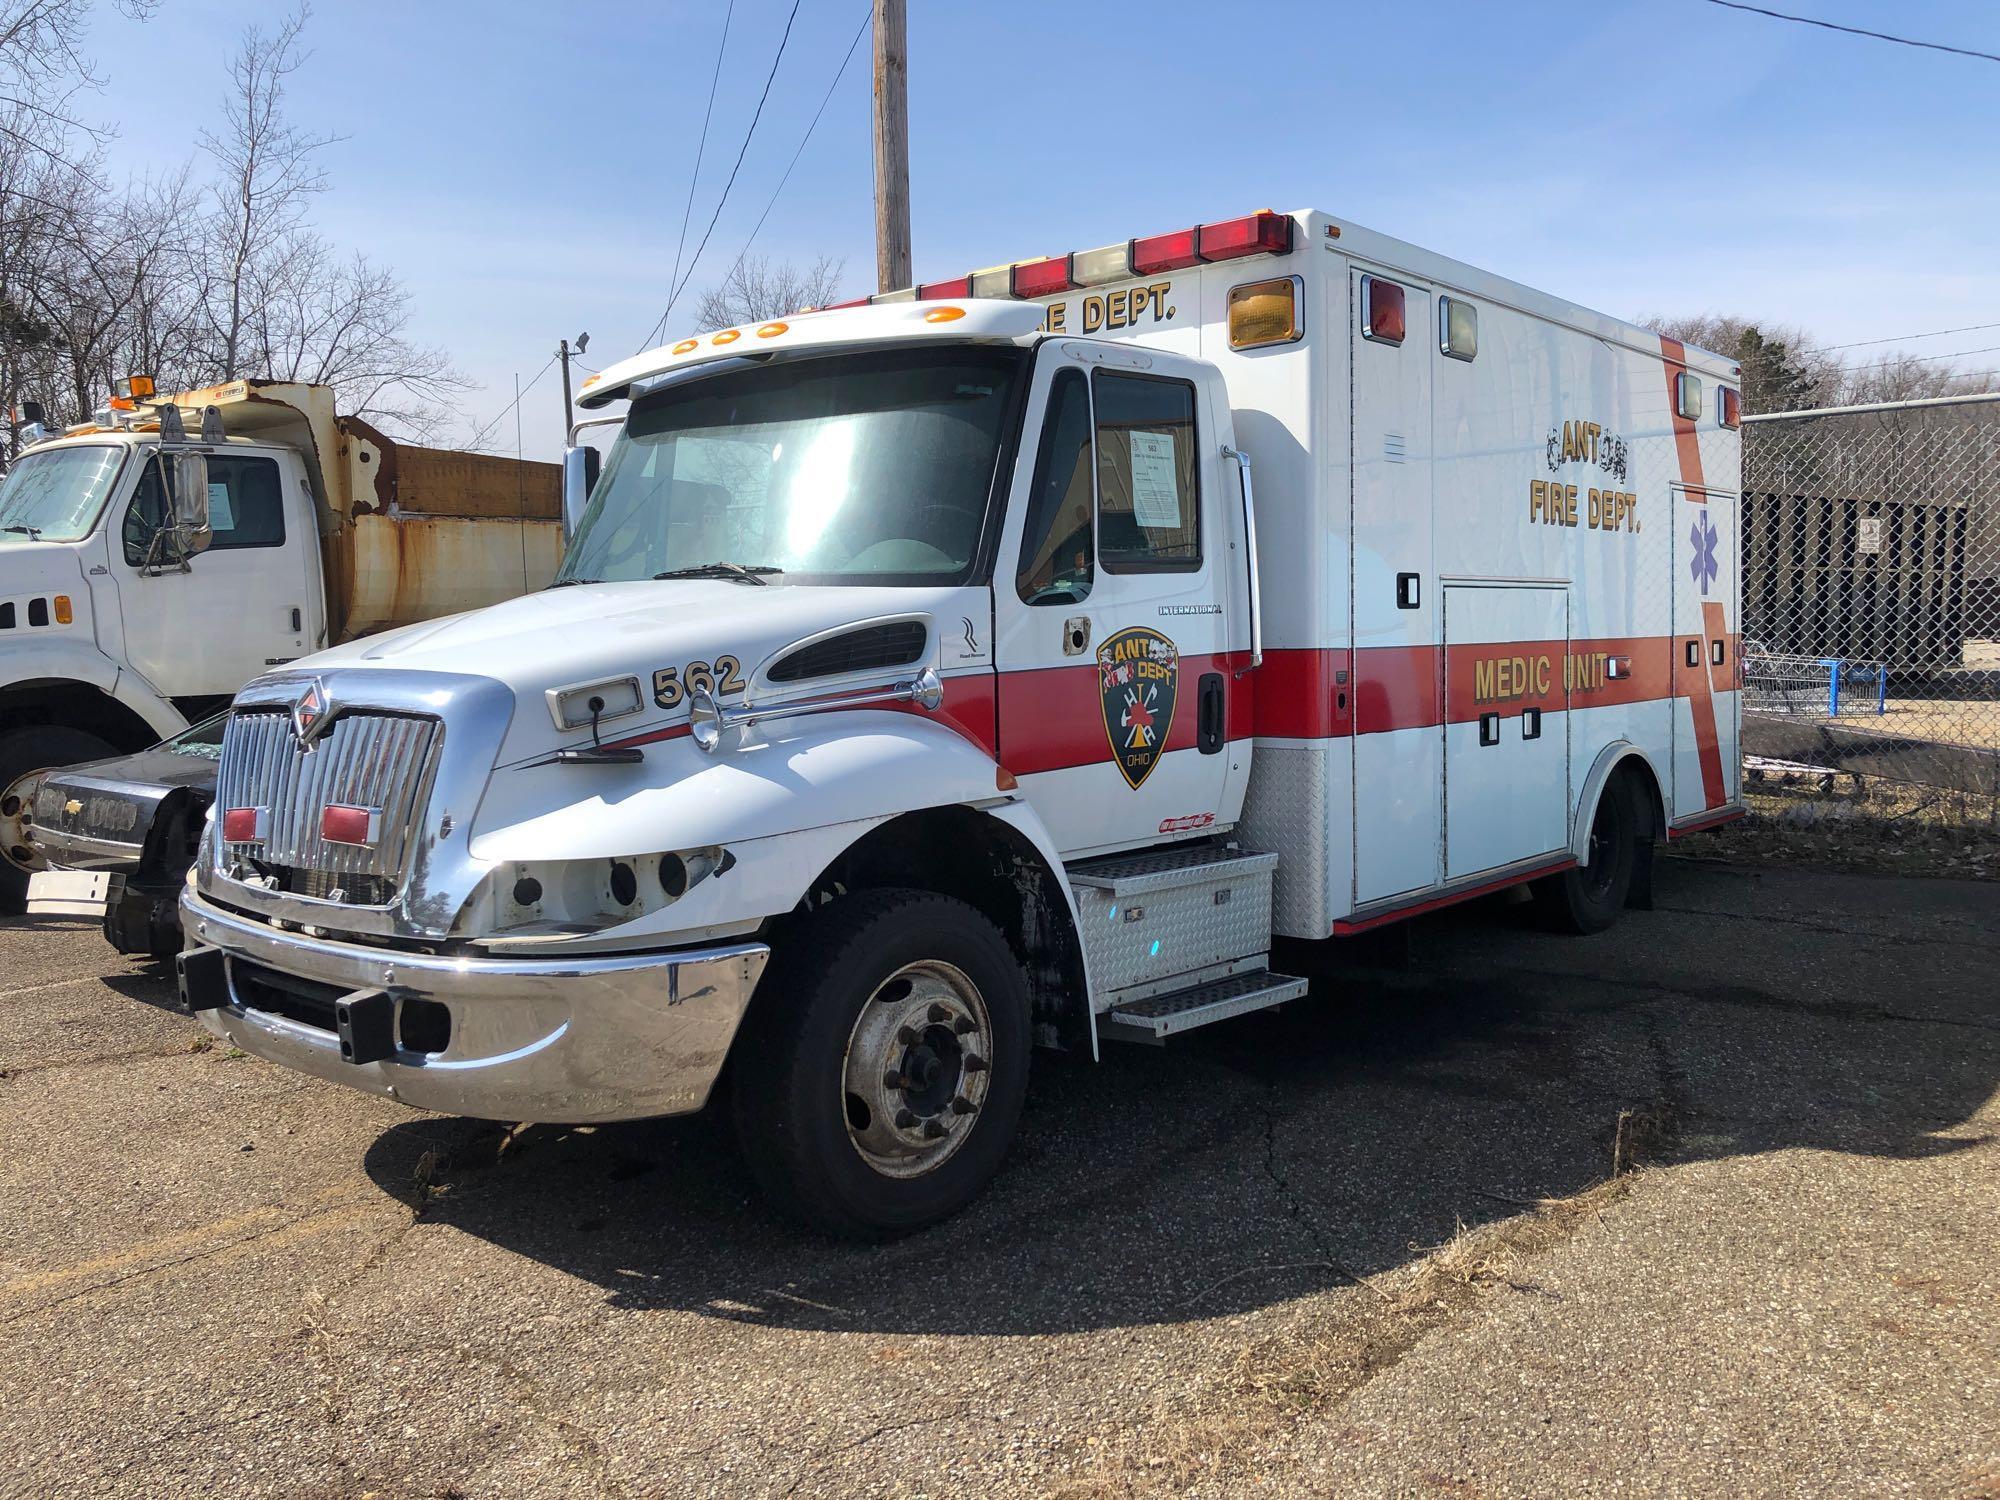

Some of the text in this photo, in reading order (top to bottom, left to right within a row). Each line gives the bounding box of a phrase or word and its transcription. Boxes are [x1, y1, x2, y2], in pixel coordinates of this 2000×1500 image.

[1083, 282, 1176, 334] DEPT.
[1530, 480, 1641, 533] FIRE DEPT.
[1158, 604, 1222, 616] INTERNATIONAL
[652, 655, 746, 709] 562
[1474, 652, 1607, 705] MEDIC UNIT
[1127, 752, 1150, 768] OHIO
